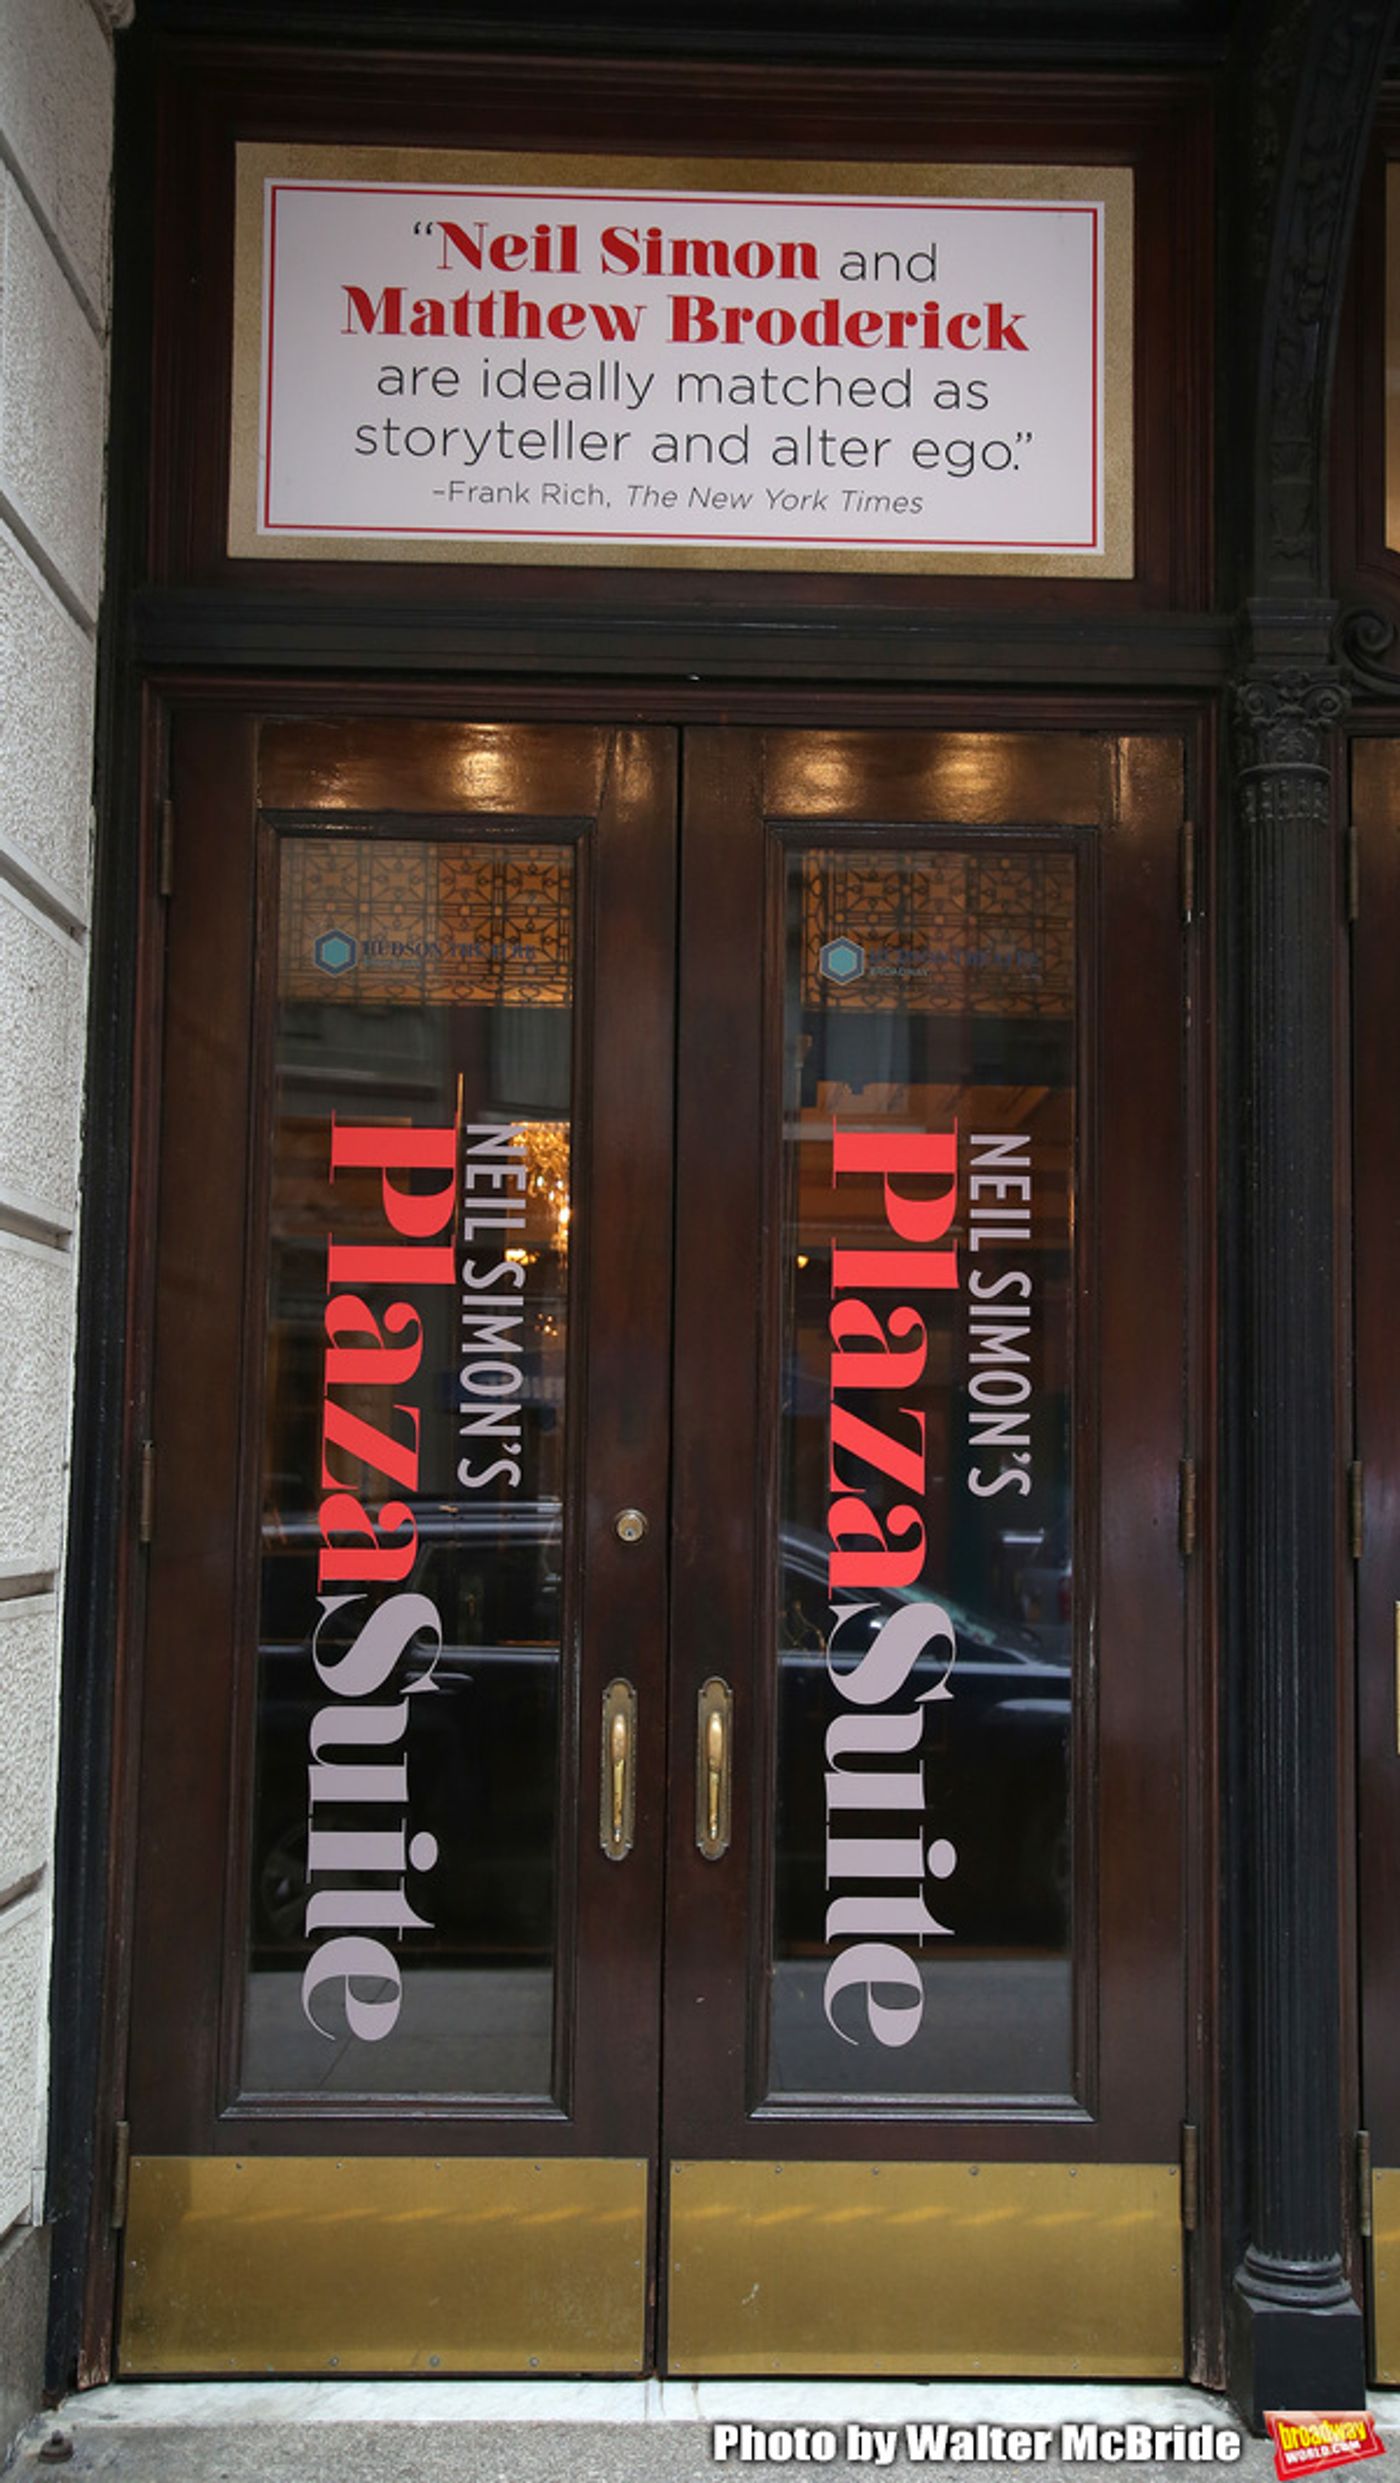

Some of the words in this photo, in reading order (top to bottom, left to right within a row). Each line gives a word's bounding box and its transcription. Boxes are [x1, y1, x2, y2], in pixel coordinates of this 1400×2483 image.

[412, 220, 581, 275] “Neil
[599, 226, 820, 281] Simon
[839, 242, 938, 284] and
[340, 284, 648, 343] Matthew
[666, 294, 1030, 352] Broderick
[353, 417, 631, 467] storyteller
[650, 424, 750, 465] and
[771, 426, 892, 468] alter
[377, 364, 460, 398] are
[482, 356, 655, 410] ideally
[677, 364, 912, 409] matched
[933, 378, 990, 411] as
[542, 482, 612, 509] Rich,
[627, 485, 679, 508] The
[688, 487, 753, 510] New
[765, 489, 828, 512] York
[841, 490, 924, 514] Times
[464, 1123, 528, 1241] NEIL
[968, 1134, 1032, 1252] NEIL
[317, 1110, 458, 1593] Plaza
[457, 1258, 526, 1489] SIMON’S
[827, 1115, 960, 1600] Plaza
[967, 1269, 1033, 1498] SIMON’S
[301, 1593, 443, 2042] Suite
[823, 1601, 957, 2049] Suite
